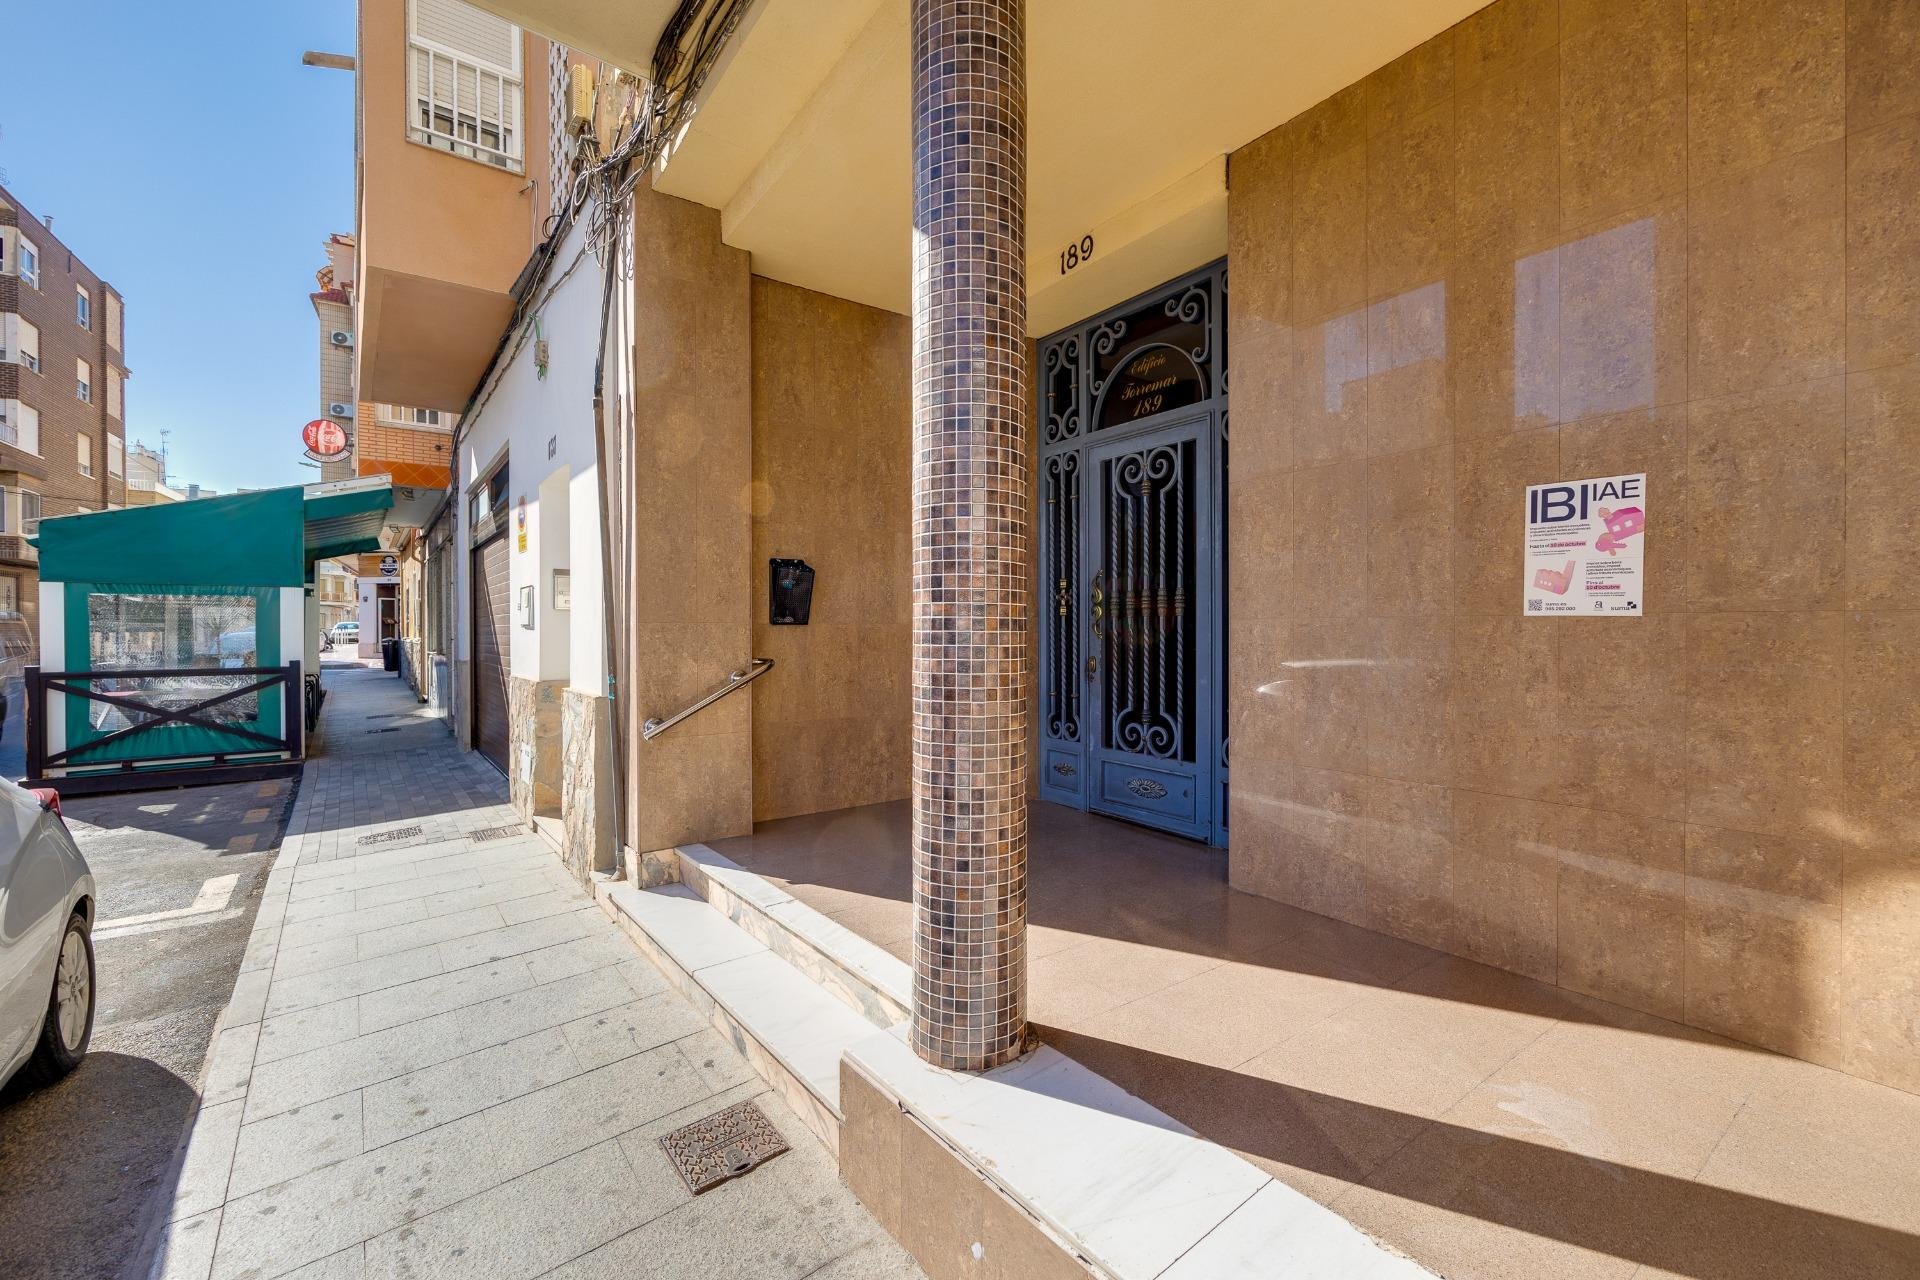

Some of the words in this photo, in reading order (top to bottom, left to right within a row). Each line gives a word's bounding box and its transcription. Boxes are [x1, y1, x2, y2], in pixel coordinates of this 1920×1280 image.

[1060, 234, 1094, 275] 189
[1130, 353, 1167, 376] Edificio
[1121, 375, 1177, 400] Torremar
[1133, 394, 1163, 417] 189
[1592, 479, 1641, 502] IAE
[1530, 484, 1588, 524] IBI
